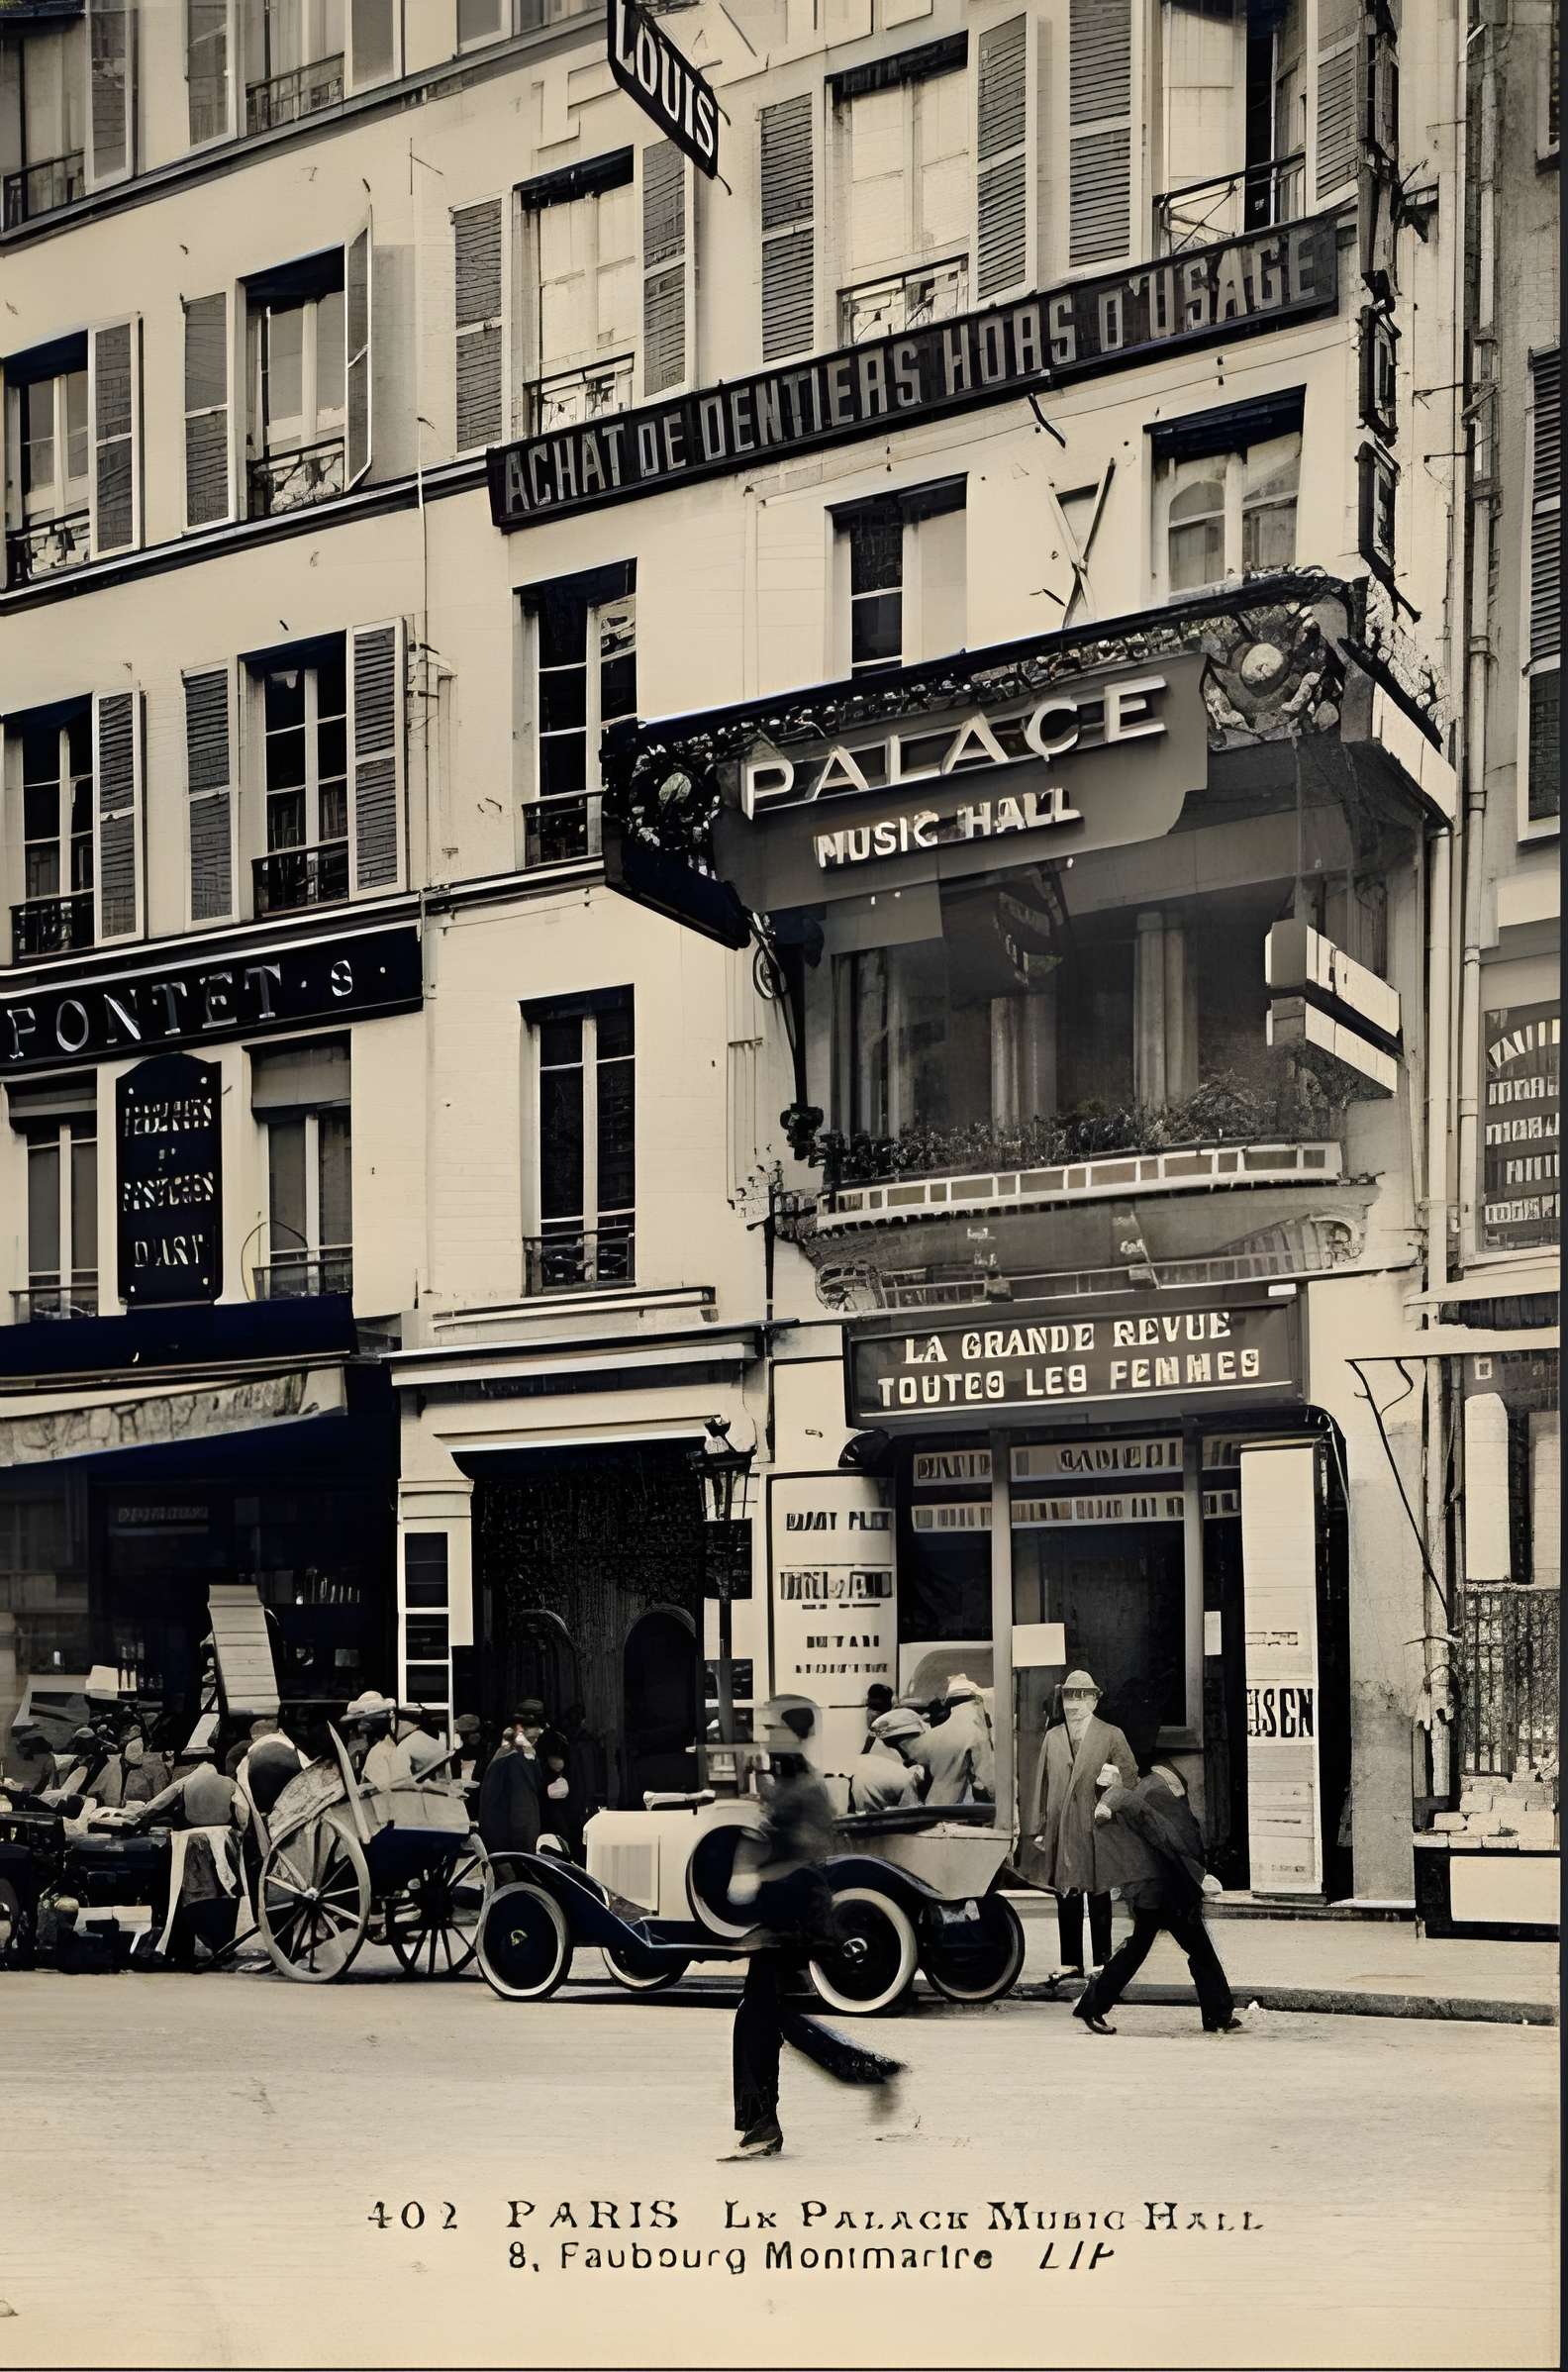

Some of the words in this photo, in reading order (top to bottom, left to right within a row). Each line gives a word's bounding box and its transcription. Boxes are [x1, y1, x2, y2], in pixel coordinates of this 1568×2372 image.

[615, 0, 715, 158] LOUIS
[505, 423, 626, 514] ACHAT
[637, 411, 687, 477] DE
[699, 340, 922, 462] DENTIERS
[942, 293, 1077, 396] HORS
[741, 674, 1167, 821] PALACE
[813, 809, 940, 869] MUSIC
[956, 787, 1081, 840] HALL
[6, 962, 283, 1060] PONTET
[903, 1337, 949, 1365] LA
[961, 1323, 1095, 1360] GRANDE
[1114, 1311, 1231, 1348] REVUE
[1026, 1364, 1088, 1397] LES
